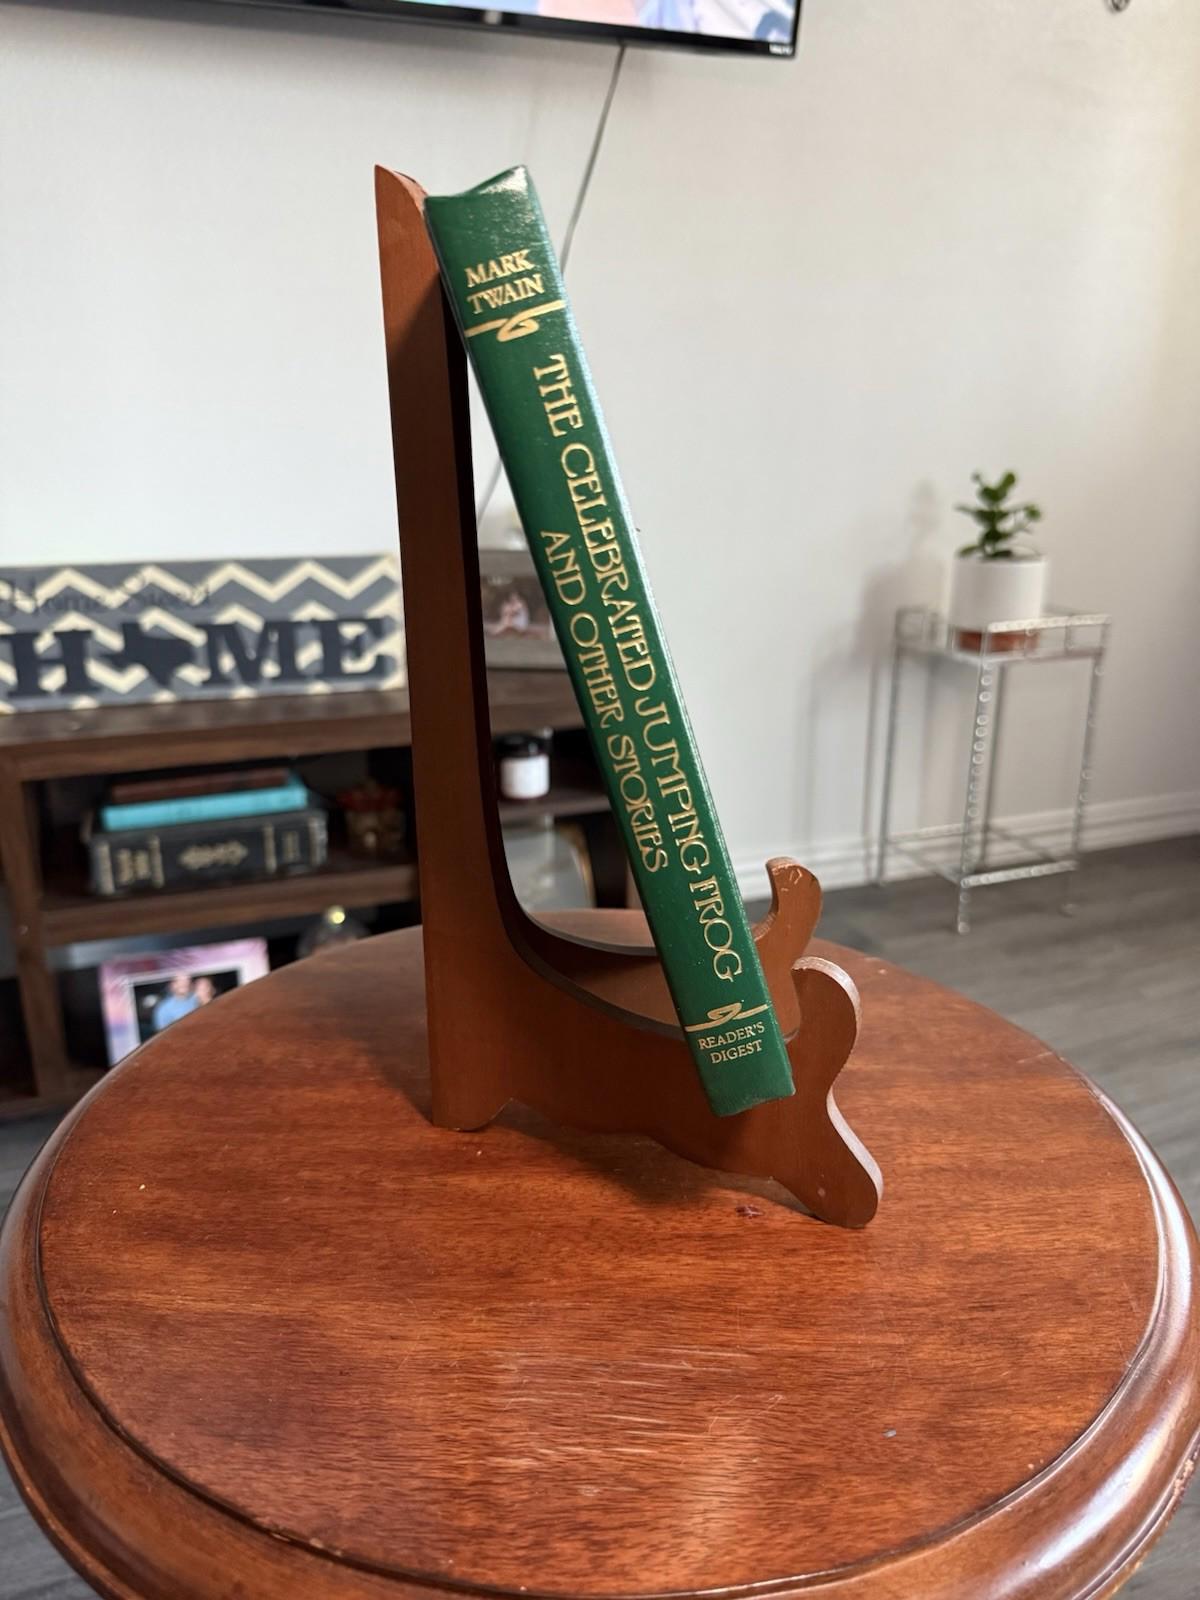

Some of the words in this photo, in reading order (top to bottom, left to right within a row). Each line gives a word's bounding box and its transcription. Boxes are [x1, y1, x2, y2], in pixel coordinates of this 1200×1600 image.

[465, 249, 536, 287] MARK
[467, 273, 545, 314] TWAIN
[0, 618, 386, 699] HME
[533, 353, 584, 437] THE
[560, 443, 657, 691] CELEBRATED
[634, 696, 711, 874] JUMPING
[689, 875, 743, 982] FROG
[540, 530, 587, 606] AND
[570, 612, 624, 729] OTHER
[606, 734, 669, 873] STORIES
[698, 1021, 766, 1050] READER'S
[710, 1039, 763, 1064] DIGEST
